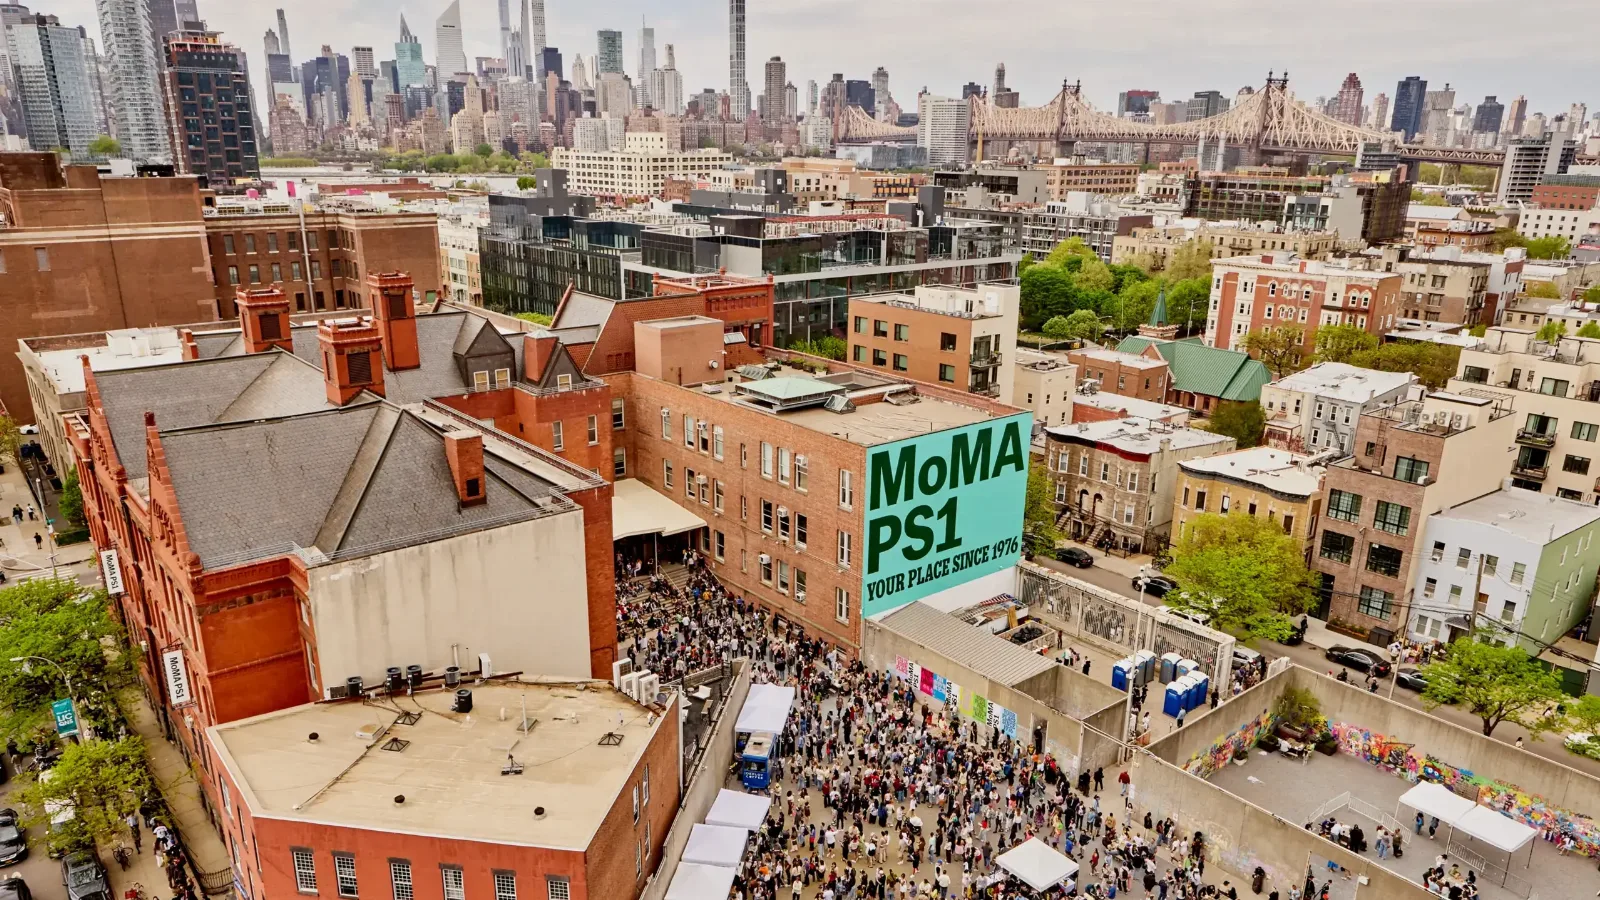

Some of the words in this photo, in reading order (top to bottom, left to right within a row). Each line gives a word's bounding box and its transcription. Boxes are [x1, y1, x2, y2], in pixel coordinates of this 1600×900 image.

[869, 421, 1025, 511] MoMA
[867, 496, 963, 575] PS1
[105, 554, 117, 576] MoMA
[867, 573, 905, 602] YOUR
[908, 557, 950, 589] PLACE
[952, 545, 990, 573] SINCE
[991, 536, 1019, 561] 1976
[110, 575, 119, 589] PS1
[169, 656, 182, 684] MoMA
[174, 682, 185, 700] PS1
